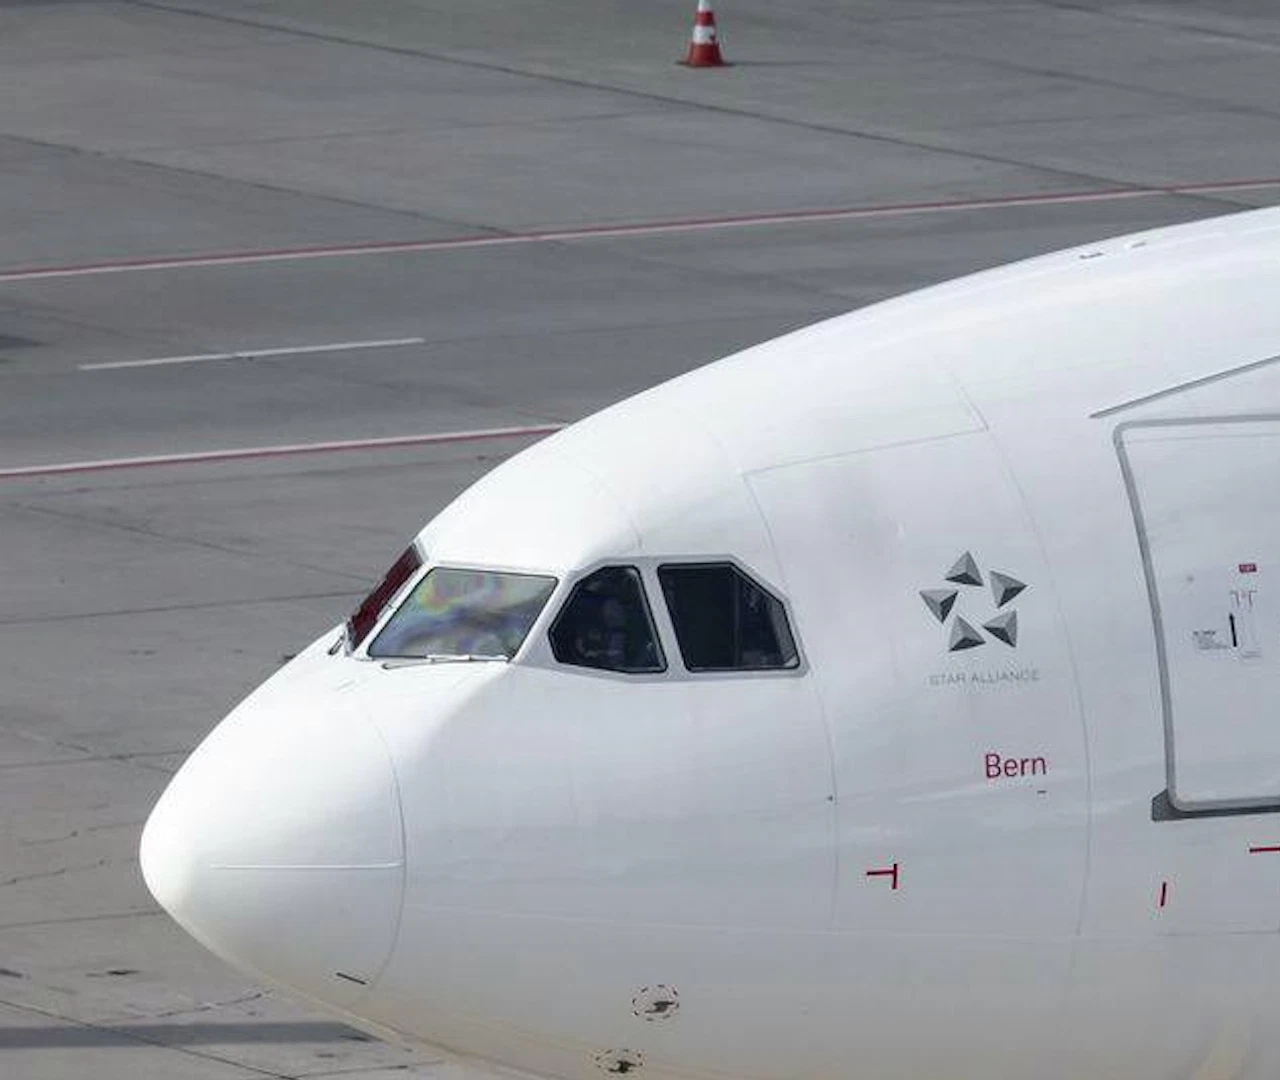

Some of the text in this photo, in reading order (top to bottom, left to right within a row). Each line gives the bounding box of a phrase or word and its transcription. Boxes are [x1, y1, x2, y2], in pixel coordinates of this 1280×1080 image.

[929, 669, 1040, 685] STAR ALLIANCE
[985, 753, 1047, 779] Bern
